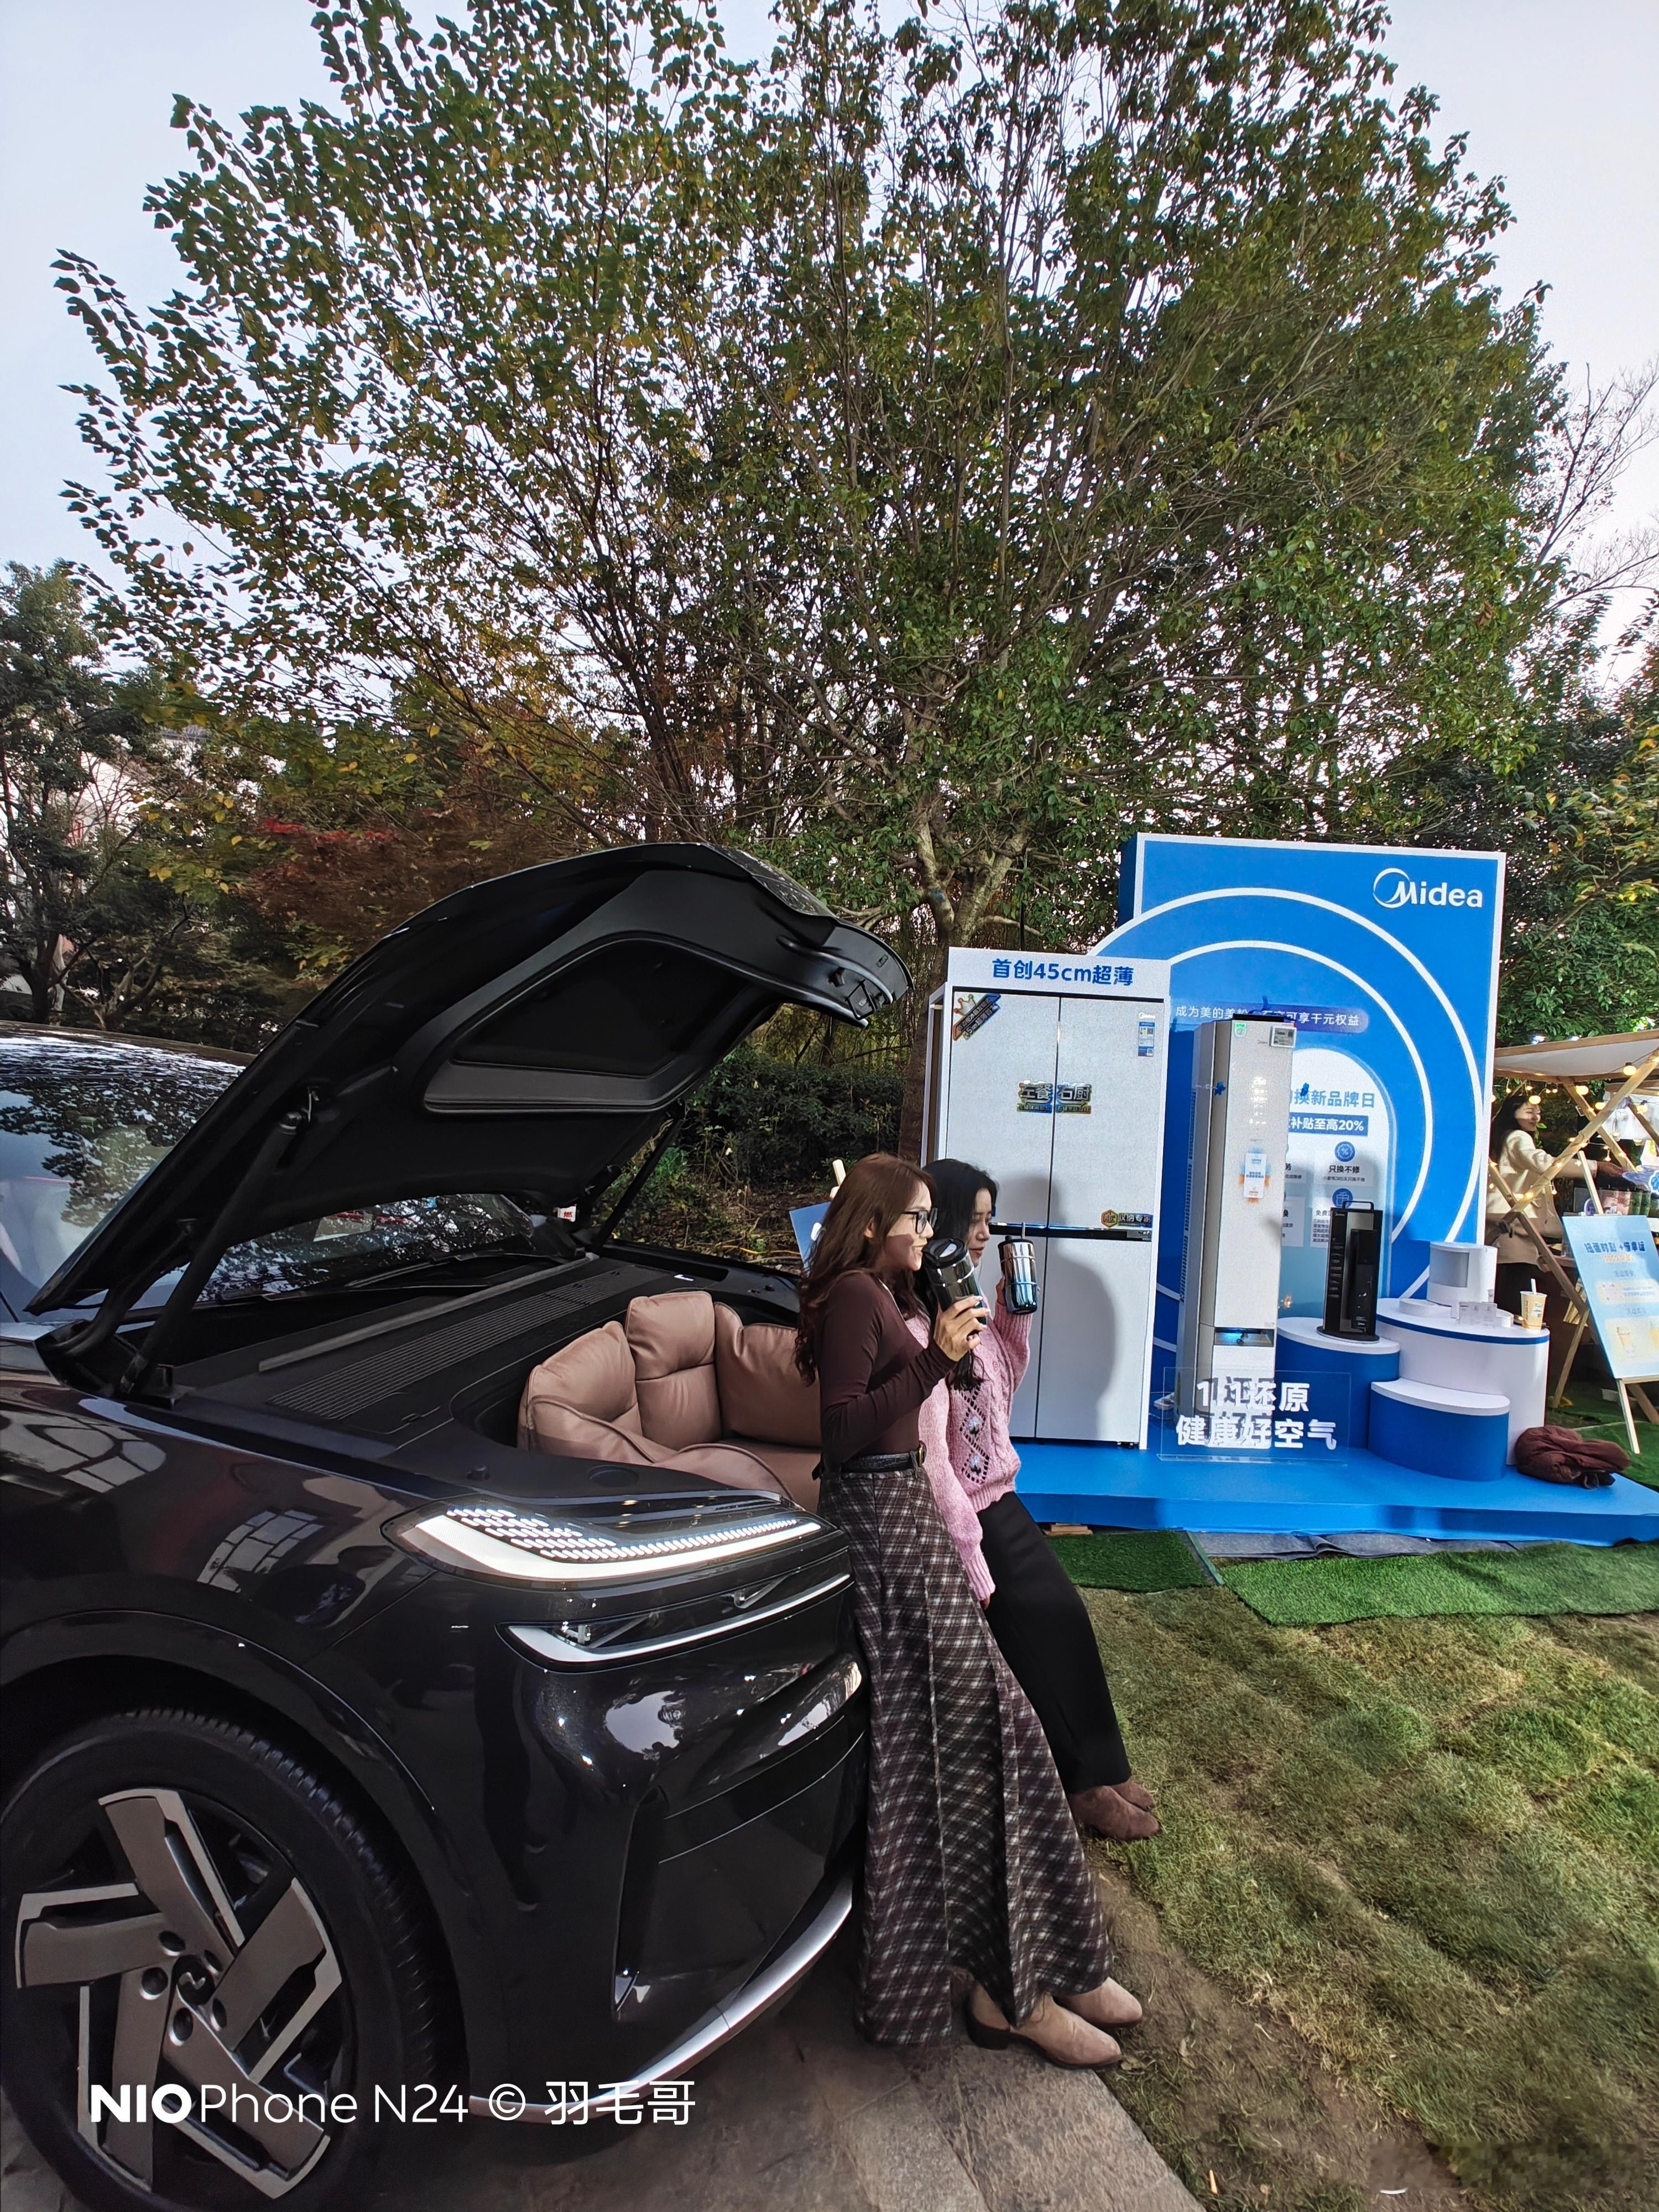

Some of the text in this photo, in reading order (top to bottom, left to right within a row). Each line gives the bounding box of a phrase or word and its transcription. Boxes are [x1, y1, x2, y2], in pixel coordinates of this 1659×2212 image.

[1373, 868, 1483, 908] Midea
[992, 958, 1134, 985] 首创45cm超薄
[1289, 1089, 1375, 1108] 换新品牌日
[1288, 1117, 1365, 1131] 补贴至高20%
[1328, 1165, 1360, 1173] 只换不修
[1176, 1415, 1337, 1450] 健康好空气
